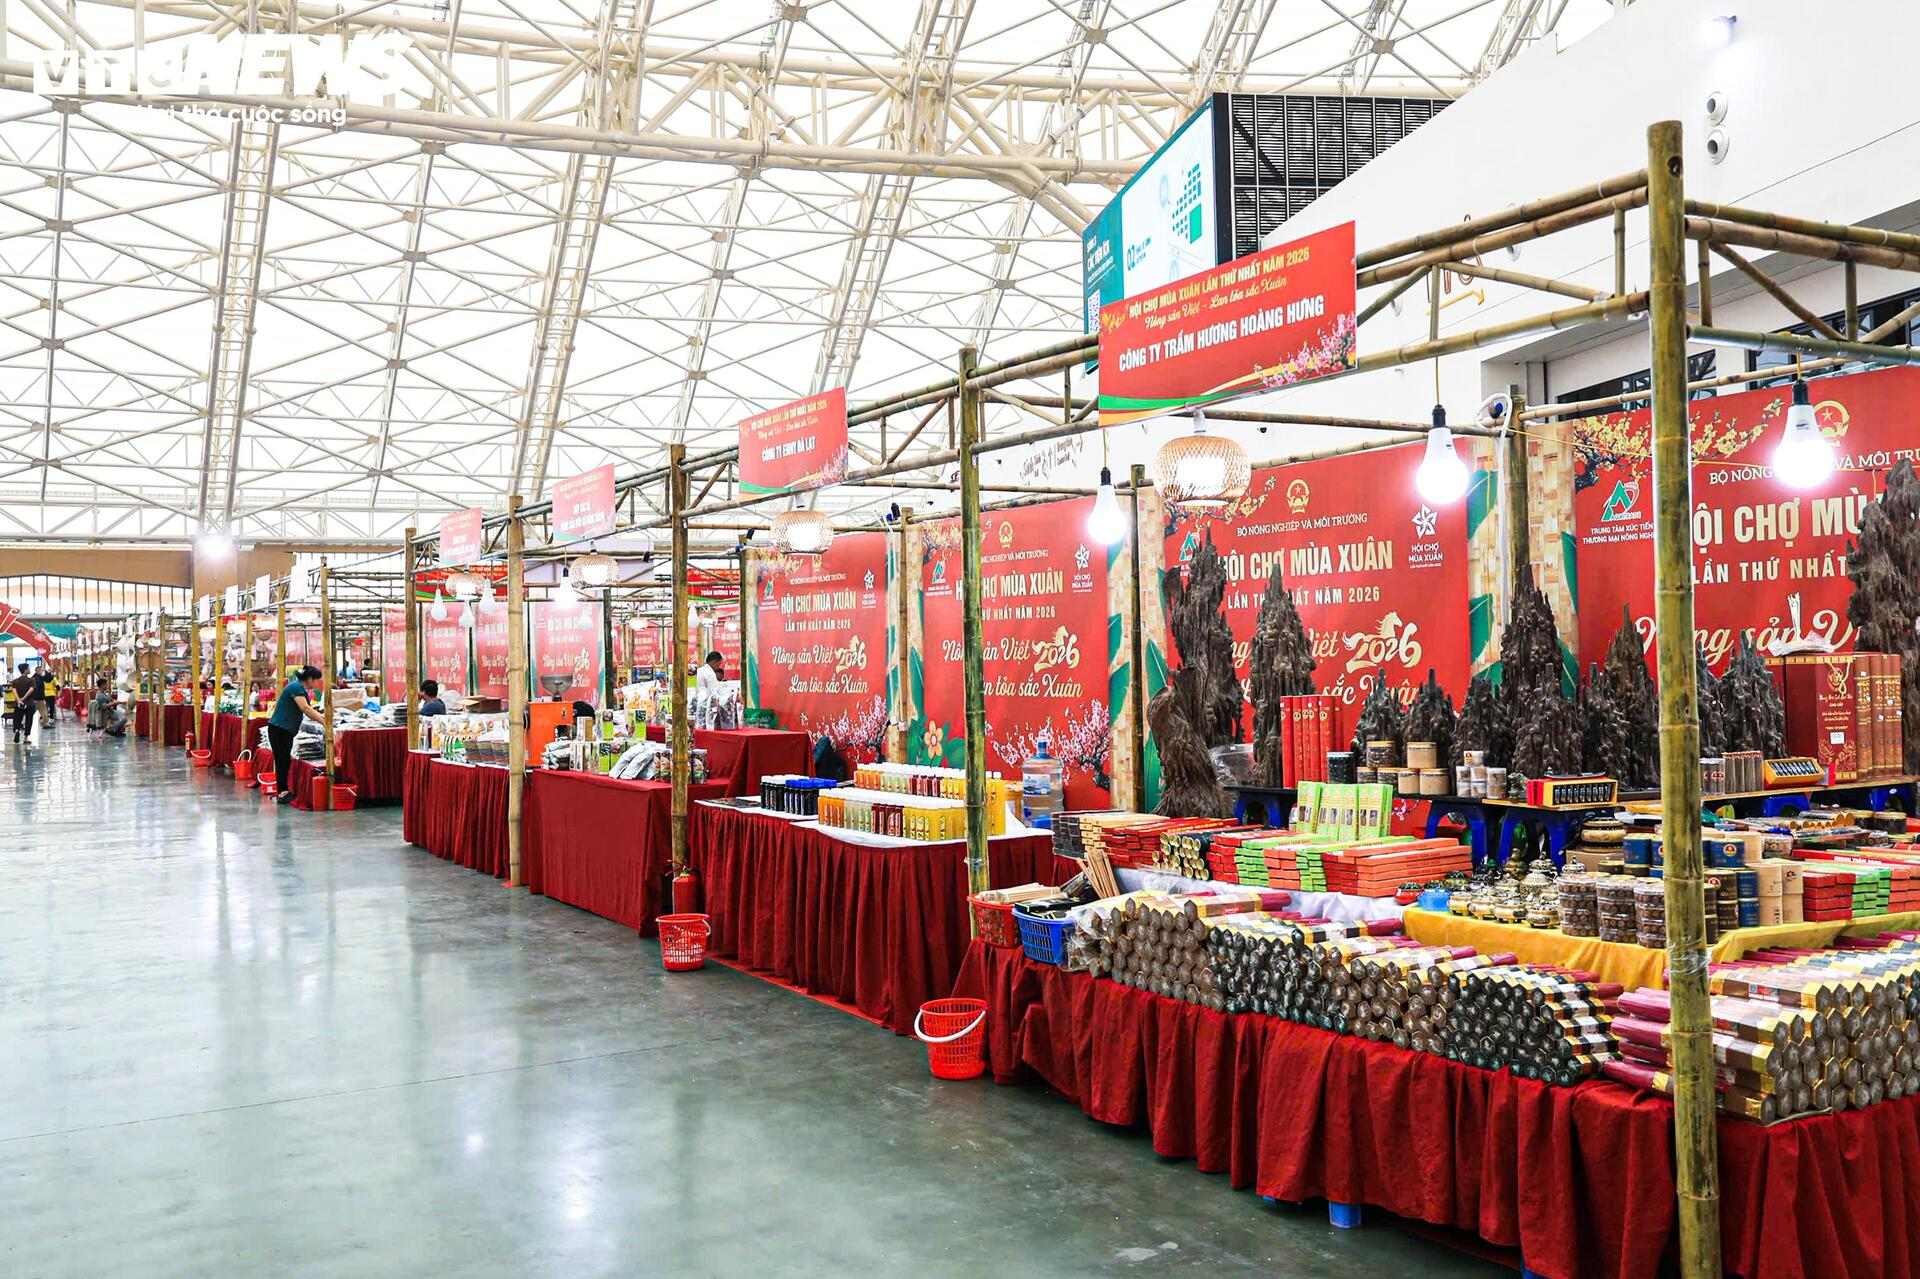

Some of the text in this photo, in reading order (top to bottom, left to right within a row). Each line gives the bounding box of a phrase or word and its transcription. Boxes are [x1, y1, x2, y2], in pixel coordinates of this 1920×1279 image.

[1129, 302, 1142, 319] HỘI
[1143, 297, 1159, 315] CHỢ
[1159, 290, 1178, 310] MÙA
[1178, 281, 1201, 300] XUÂN
[1220, 267, 1236, 289] THỨ
[1238, 261, 1262, 284] NHẤT
[1263, 254, 1285, 275] NĂM
[1286, 246, 1310, 267] 2026
[1119, 347, 1147, 372] CÔNG
[1149, 342, 1162, 362] TY
[1197, 322, 1238, 349] HƯƠNG
[1240, 313, 1284, 341] HOÀNG
[1287, 295, 1325, 324] HƯNG
[1858, 450, 1891, 468] MÔI
[1709, 466, 1773, 486] BỘ NÔNG
[1237, 513, 1368, 538] BỘ NÔNG NGHIỆP VÀ MÔI TRƯỜNG
[1591, 521, 1654, 535] TRUNG TÂM XÚC TIẾN
[1693, 487, 1884, 554] ỘI CHỢ MÙ
[1411, 542, 1439, 553] HỘI CHỢ
[1583, 536, 1608, 544] THƯƠNG
[1608, 534, 1620, 543] MẠI
[1620, 533, 1638, 541] NÔNG
[1290, 541, 1332, 577] MÙA
[1338, 536, 1393, 573] XUÂN
[1408, 552, 1443, 563] MÙA XUÂN
[1739, 556, 1780, 582] THỨ
[1789, 550, 1848, 579] NHẤT
[1001, 570, 1027, 597] MÙA
[1030, 568, 1064, 596] XUÂN
[781, 592, 794, 618] HỘI
[795, 592, 811, 616] CHỢ
[813, 589, 833, 613] MÙA
[833, 587, 857, 610] XUÂN
[1227, 590, 1248, 609] LẦN
[1315, 586, 1342, 604] NĂM
[1349, 586, 1380, 602] 2026
[1016, 605, 1032, 619] NĂM
[1036, 605, 1056, 618] 2026
[772, 645, 796, 671] Nông
[797, 648, 813, 664] sản
[813, 644, 834, 667] Việt
[1001, 637, 1031, 665] Việt
[1309, 628, 1339, 664] iệt
[789, 674, 809, 693] Lan
[825, 673, 841, 694] sắc
[841, 674, 869, 694] Xuân
[996, 675, 1018, 696] tỏa
[1019, 673, 1040, 696] sắc
[1042, 673, 1083, 698] Xuân
